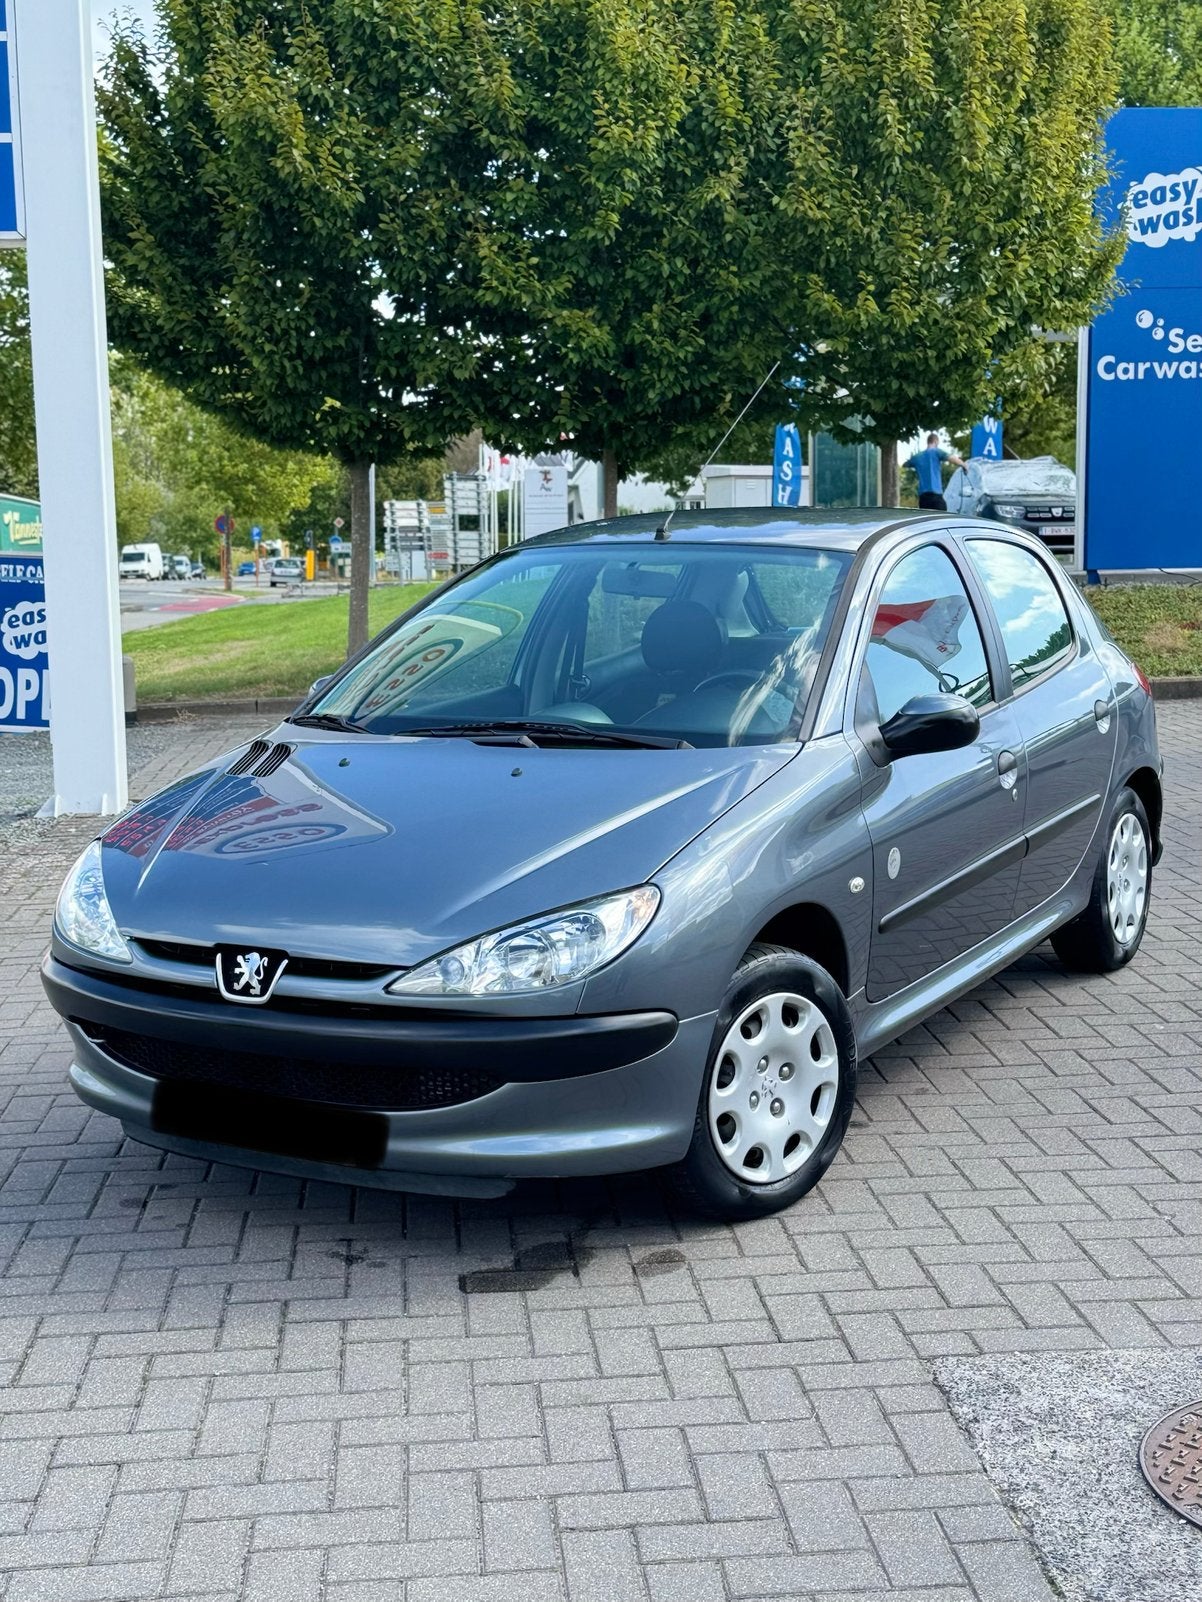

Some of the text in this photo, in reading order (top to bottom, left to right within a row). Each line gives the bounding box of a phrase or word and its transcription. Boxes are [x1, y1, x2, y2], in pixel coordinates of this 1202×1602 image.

[1132, 178, 1199, 209] easy
[1168, 328, 1202, 354] Se
[1097, 355, 1202, 381] Carwa
[983, 414, 998, 457] WA
[0, 564, 25, 583] ELF
